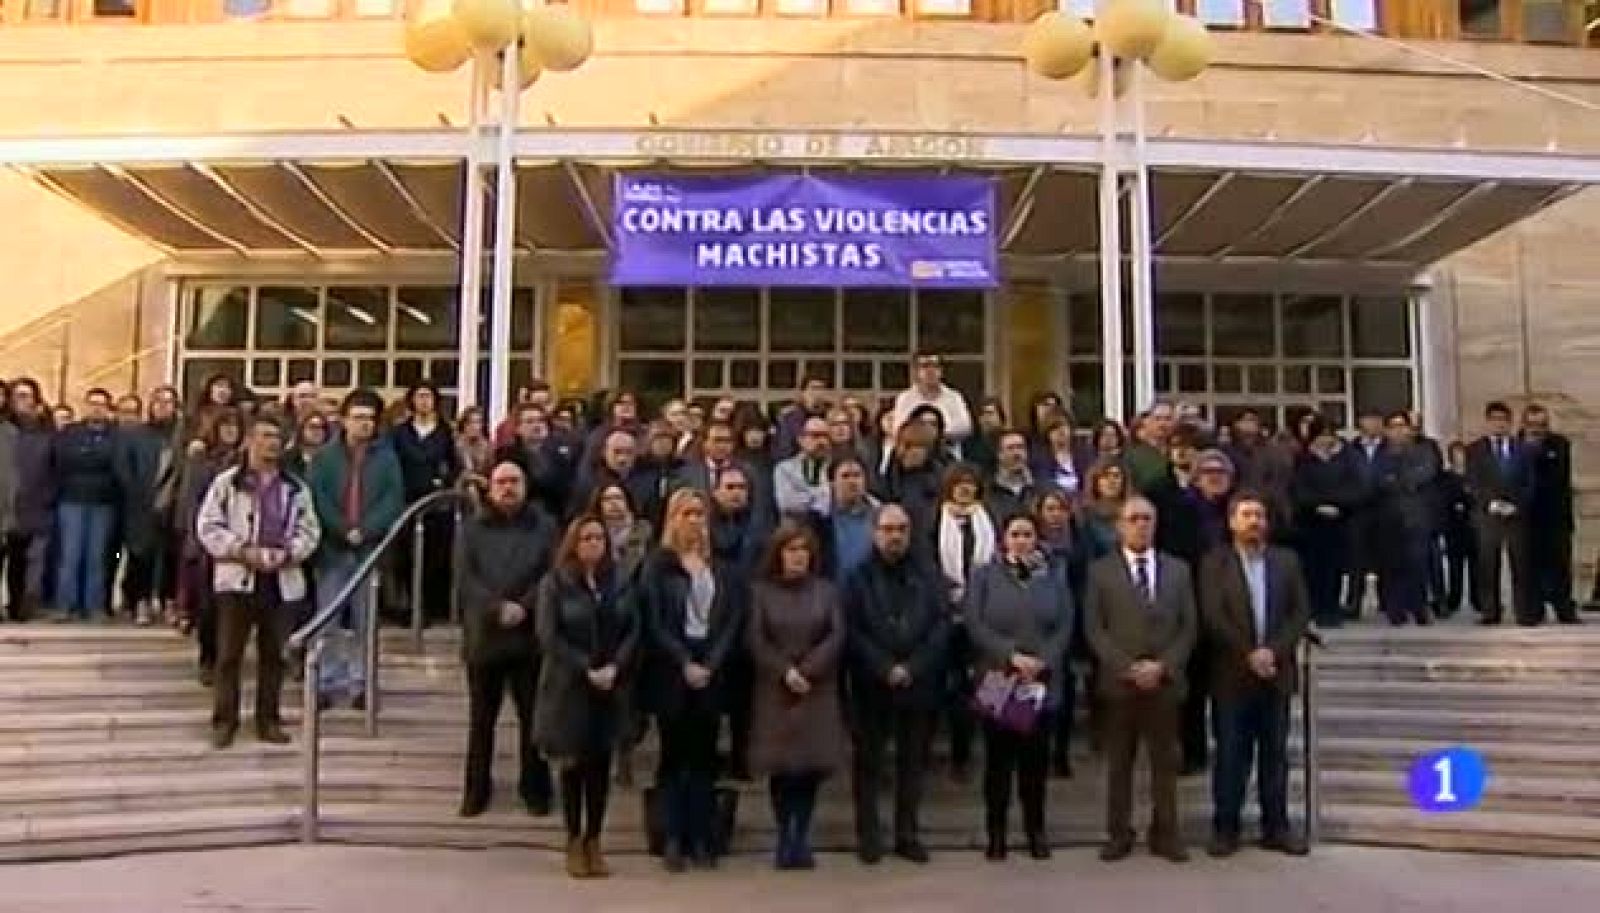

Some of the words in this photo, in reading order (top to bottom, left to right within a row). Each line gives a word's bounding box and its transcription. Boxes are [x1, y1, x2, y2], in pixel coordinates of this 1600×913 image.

[622, 207, 743, 234] CONTRA
[752, 207, 806, 233] LAS
[813, 208, 989, 236] VIOLENCIAS
[697, 241, 883, 269] MACHISTAS
